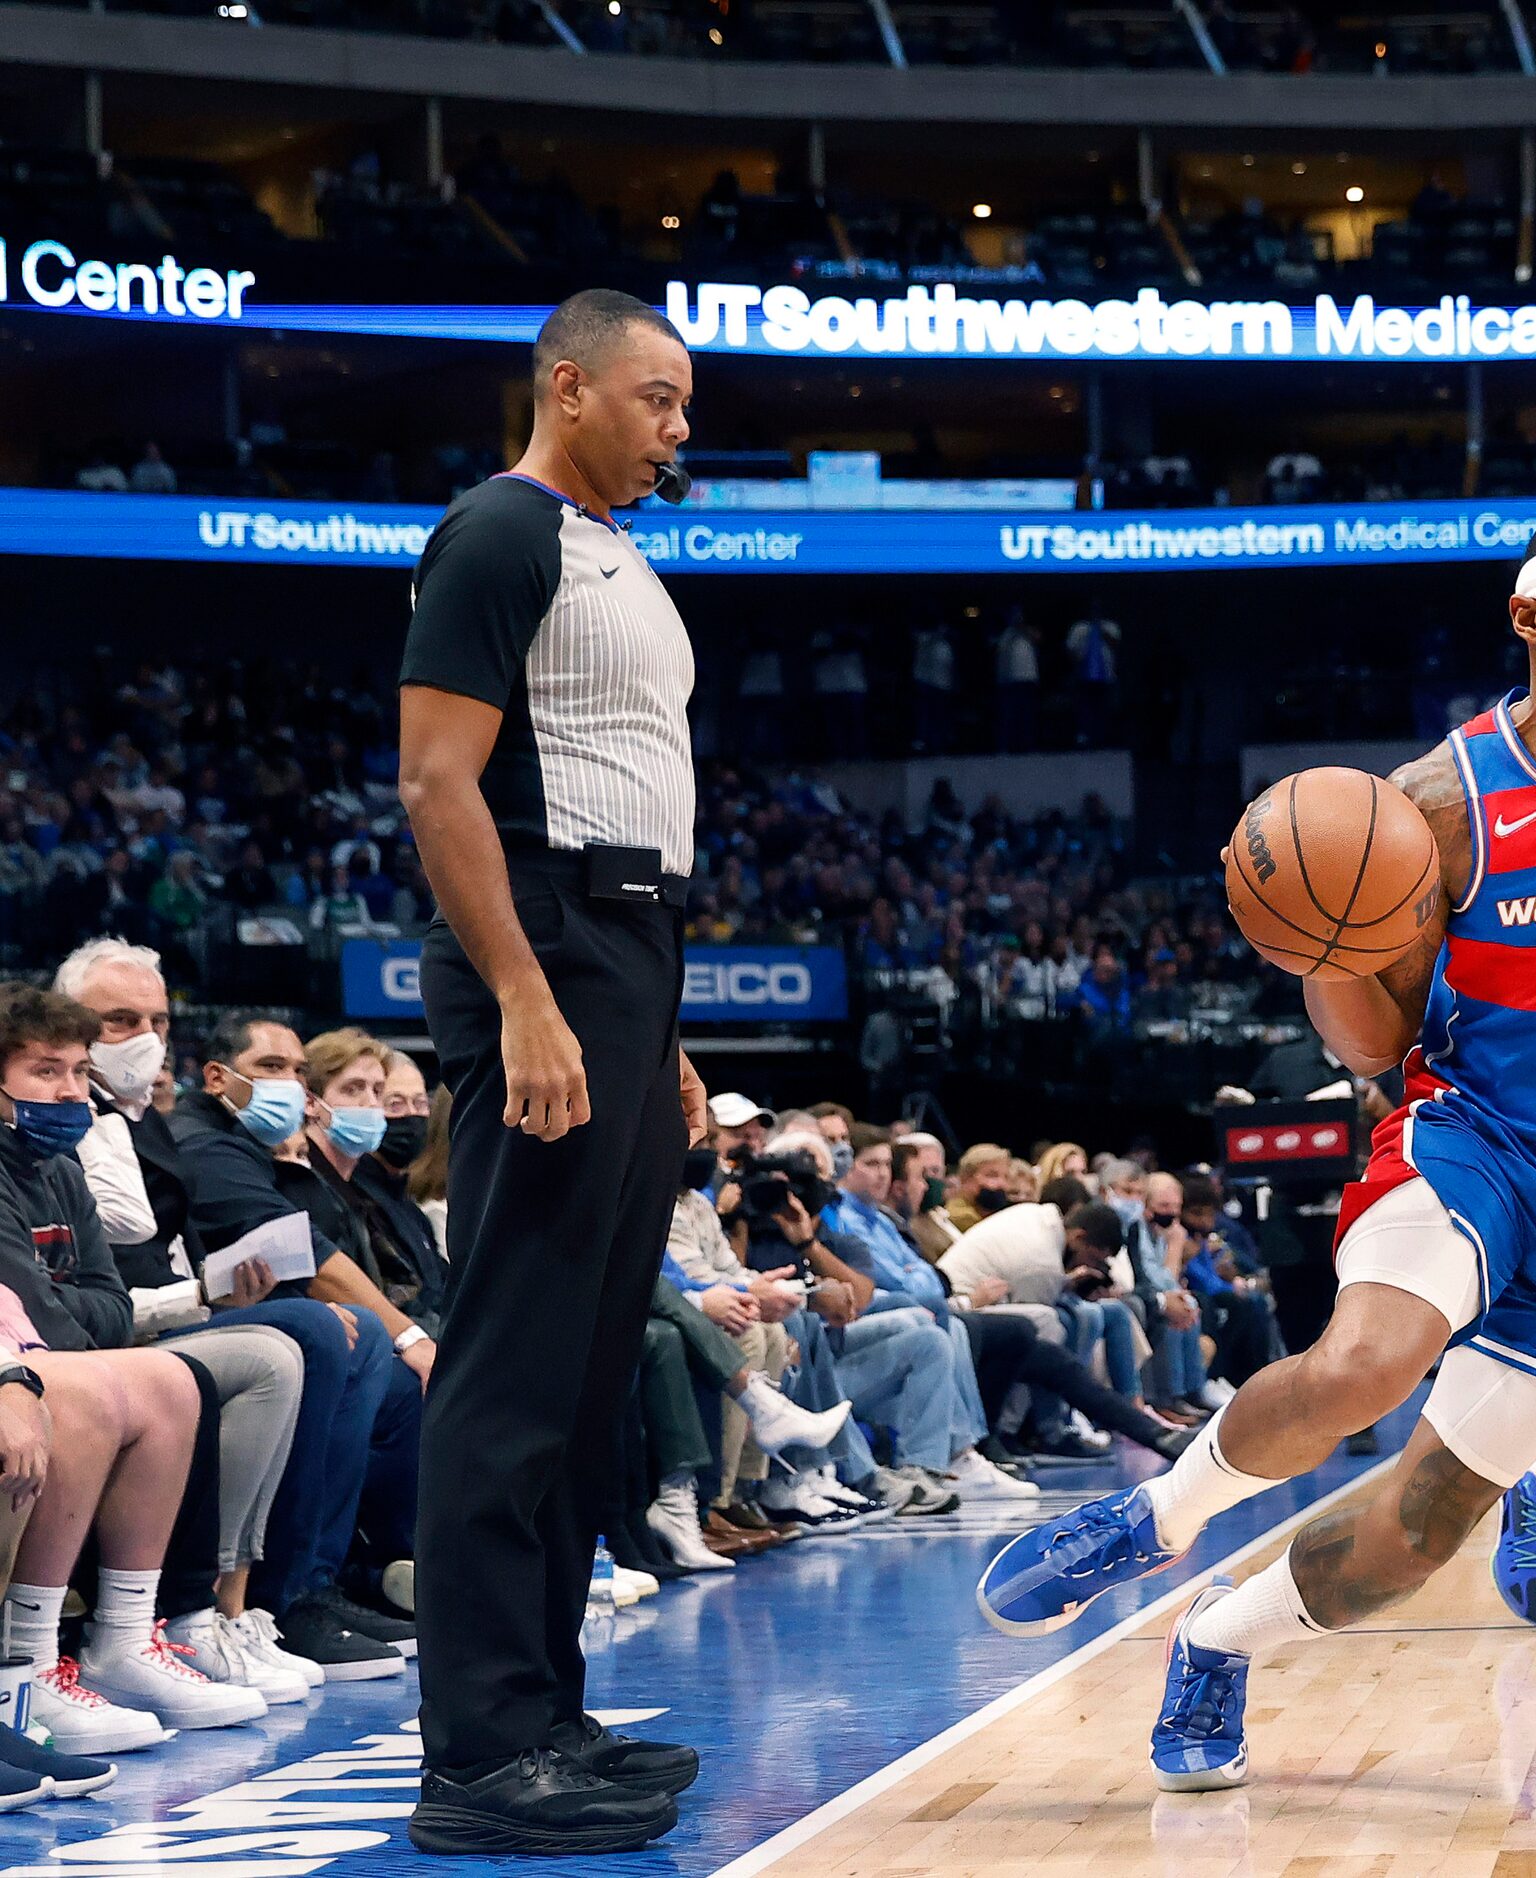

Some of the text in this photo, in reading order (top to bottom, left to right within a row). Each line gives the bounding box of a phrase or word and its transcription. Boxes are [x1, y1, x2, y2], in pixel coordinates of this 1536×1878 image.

[22, 240, 256, 319] Center
[685, 525, 803, 561] Center
[1335, 518, 1468, 552] Medical
